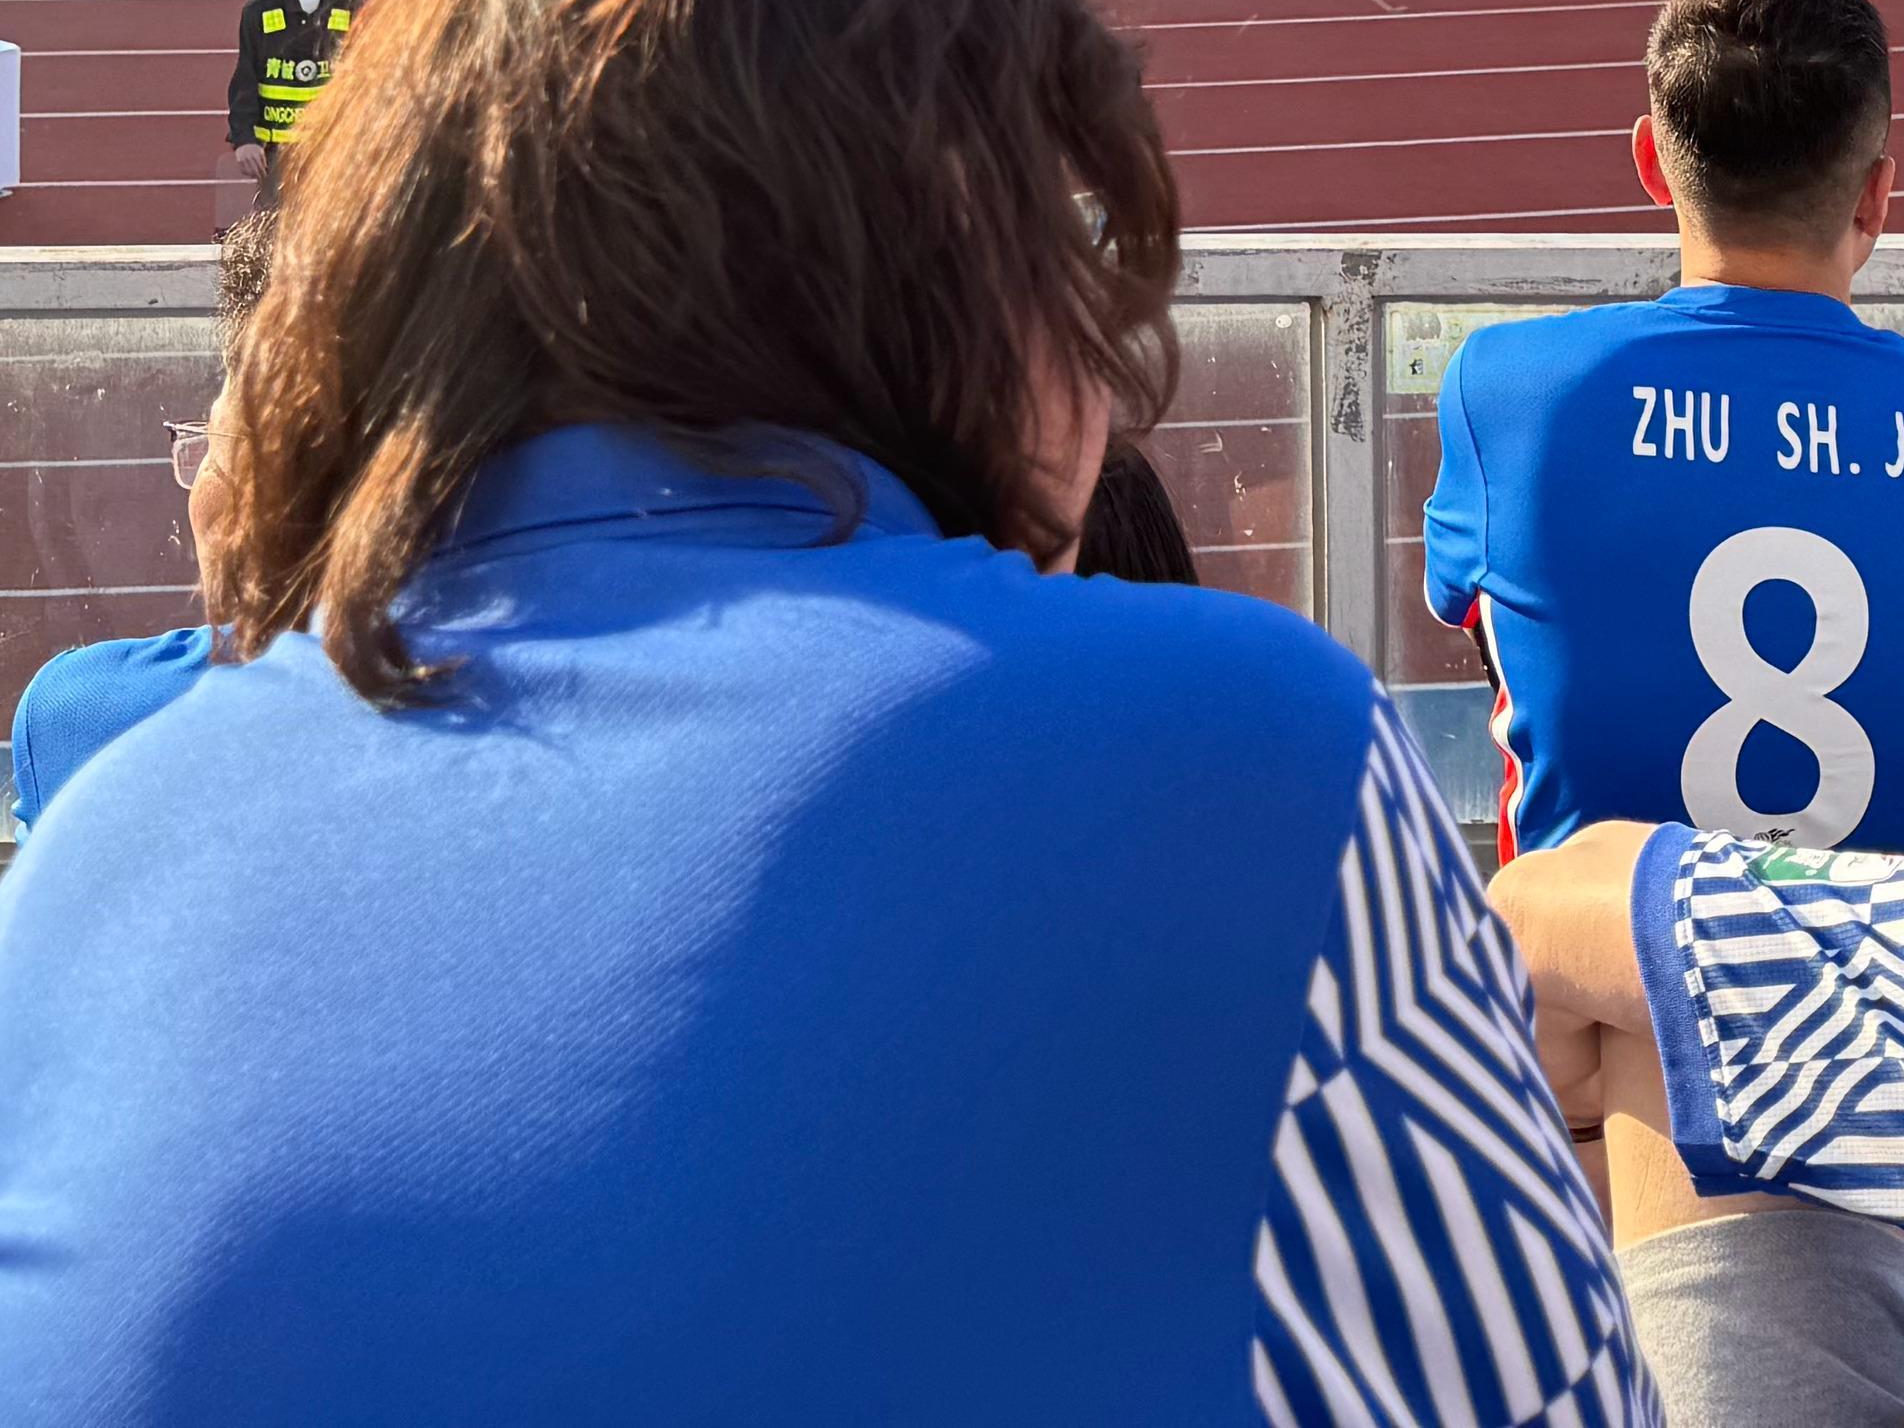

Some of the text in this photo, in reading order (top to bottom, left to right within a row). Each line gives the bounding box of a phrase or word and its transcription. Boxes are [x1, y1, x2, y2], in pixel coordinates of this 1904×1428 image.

[1632, 386, 1730, 463] ZHU
[1775, 400, 1862, 475] SH.
[1680, 526, 1876, 850] 8
